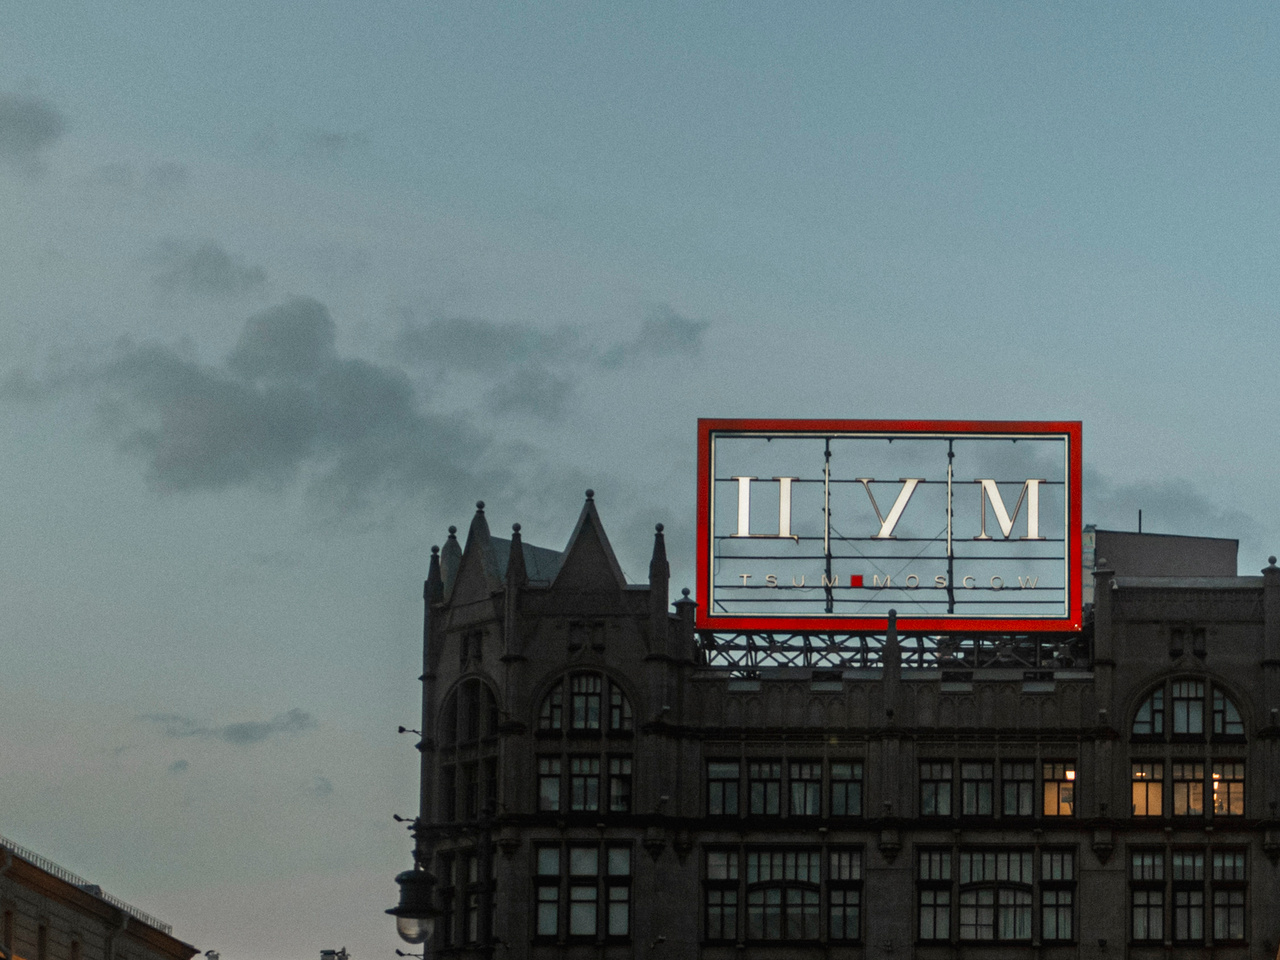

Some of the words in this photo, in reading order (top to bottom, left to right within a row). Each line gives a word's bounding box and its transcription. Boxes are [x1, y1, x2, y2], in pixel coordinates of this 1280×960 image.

[730, 476, 1046, 544] ЦУМ
[739, 574, 839, 588] TSUM
[873, 574, 1039, 589] MOSCOW
